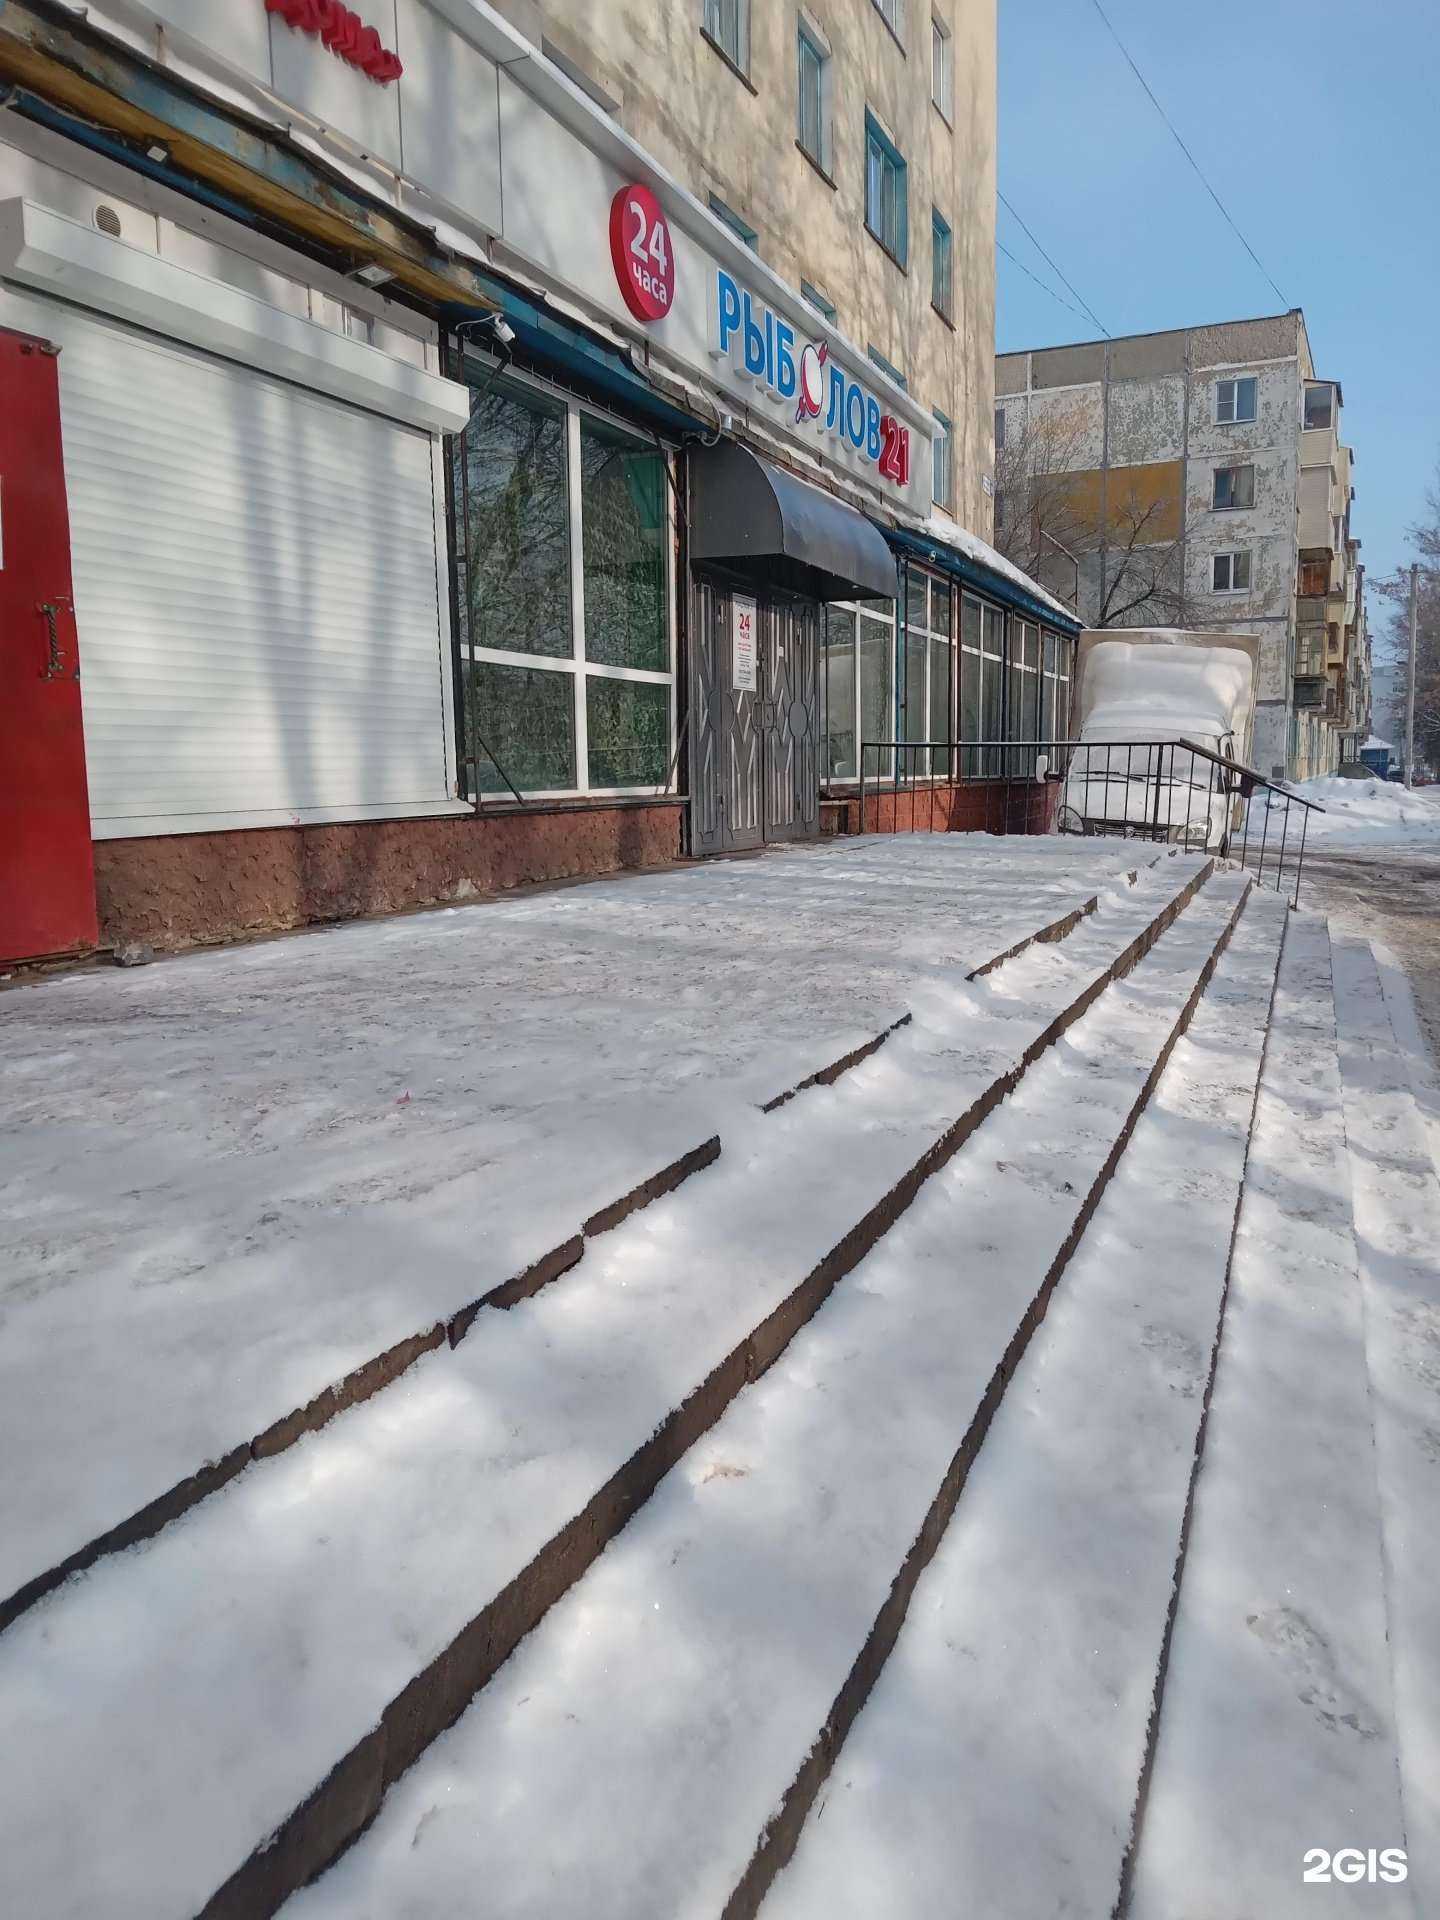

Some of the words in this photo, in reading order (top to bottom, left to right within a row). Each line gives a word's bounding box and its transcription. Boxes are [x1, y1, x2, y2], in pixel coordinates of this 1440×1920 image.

[630, 201, 667, 277] 24
[632, 262, 667, 305] часа
[739, 612, 751, 631] 24
